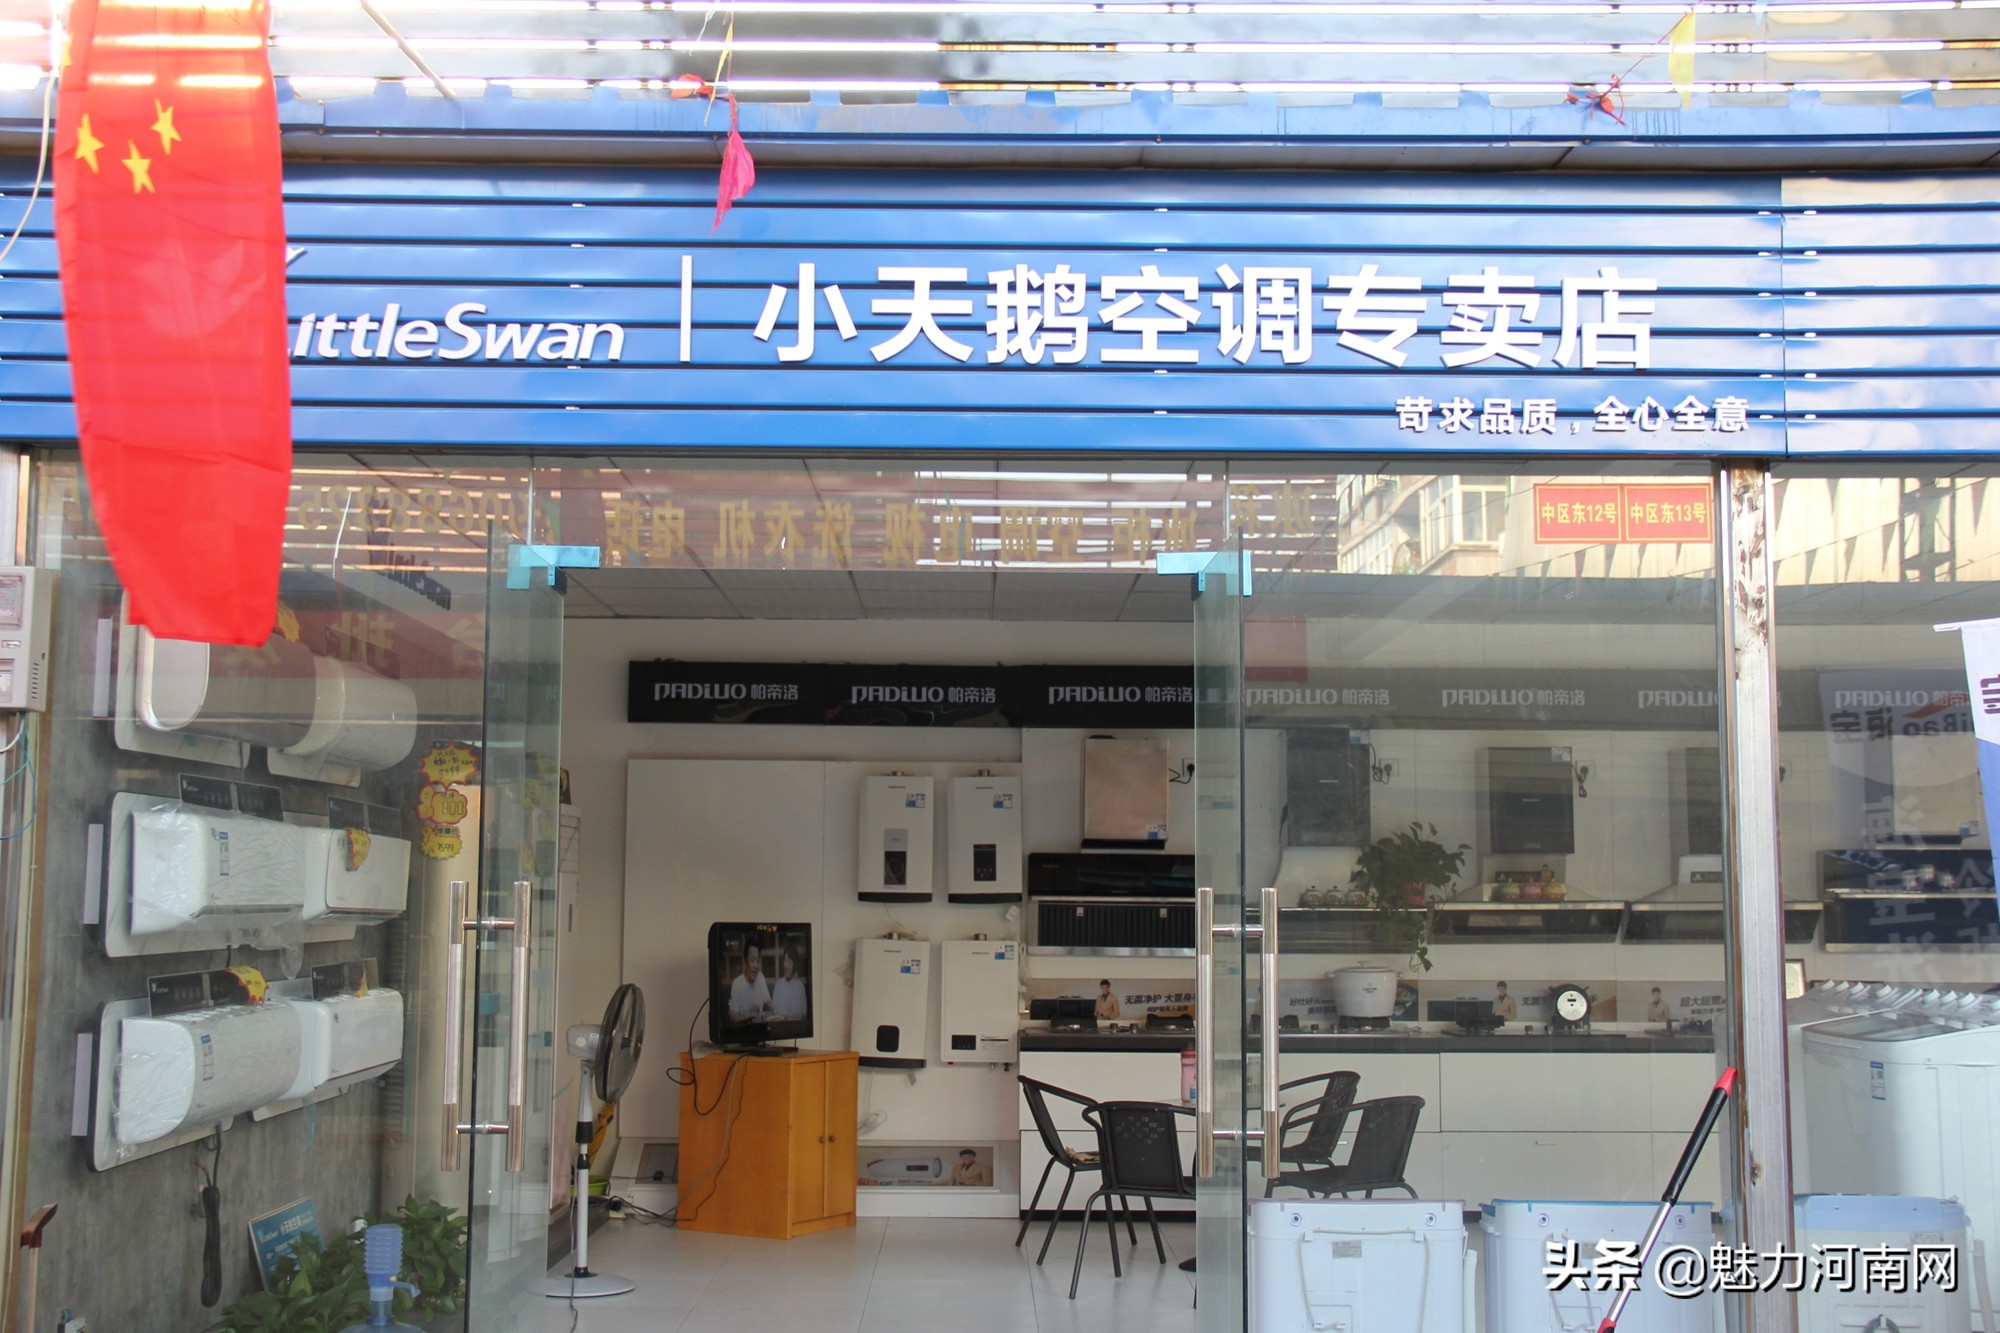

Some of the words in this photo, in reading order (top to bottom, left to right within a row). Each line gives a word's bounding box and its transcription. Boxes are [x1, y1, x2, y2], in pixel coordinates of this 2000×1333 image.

[753, 262, 1658, 369] 小天鹅空调专卖店
[288, 302, 625, 361] ittleSwan
[1395, 395, 1750, 435] 苛求品质，全心全意
[1542, 502, 1617, 524] 中区东12号
[1631, 502, 1706, 524] 中区东13号
[751, 683, 799, 700] 帕帝洛
[947, 686, 997, 704] 帕帝洛
[1144, 686, 1194, 704] 帕帝洛
[1342, 688, 1390, 706] 帕帝洛
[1537, 689, 1586, 706] 帕帝洛
